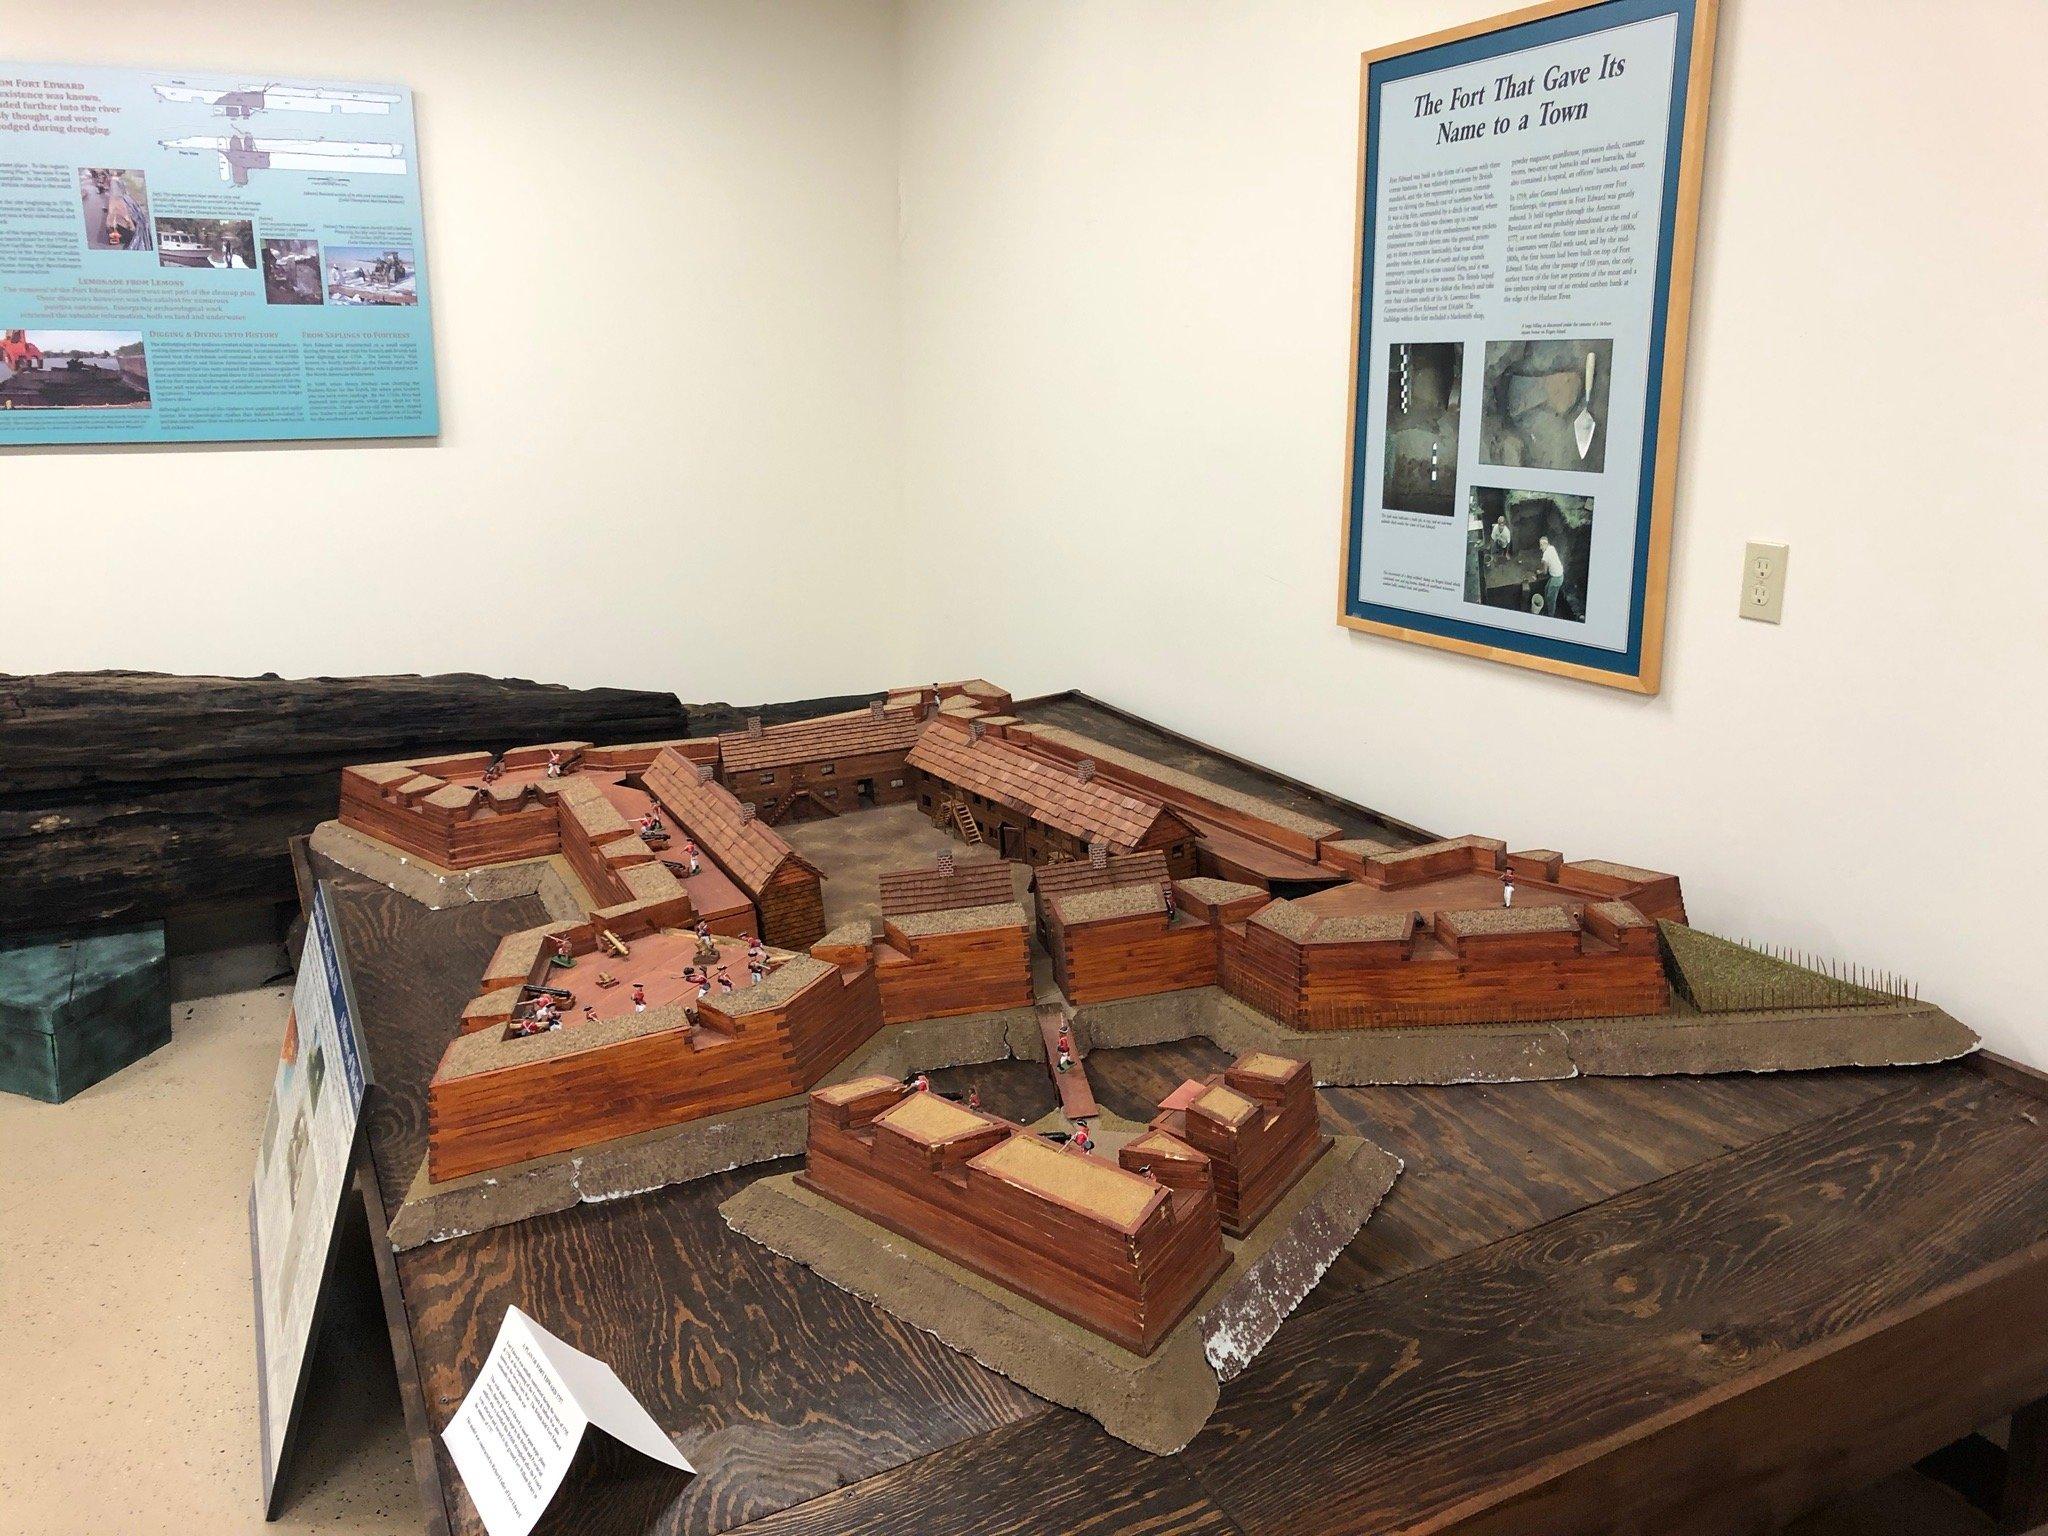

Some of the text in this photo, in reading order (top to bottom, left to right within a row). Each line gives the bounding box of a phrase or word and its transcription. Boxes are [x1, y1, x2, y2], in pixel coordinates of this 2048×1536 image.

[1414, 53, 1625, 118] The Fort That Gave Its
[60, 102, 79, 111] into
[81, 103, 96, 112] the
[98, 104, 122, 114] river
[12, 112, 52, 122] thought,
[54, 114, 72, 122] and
[1436, 101, 1589, 145] Name to a Town
[32, 123, 65, 133] during
